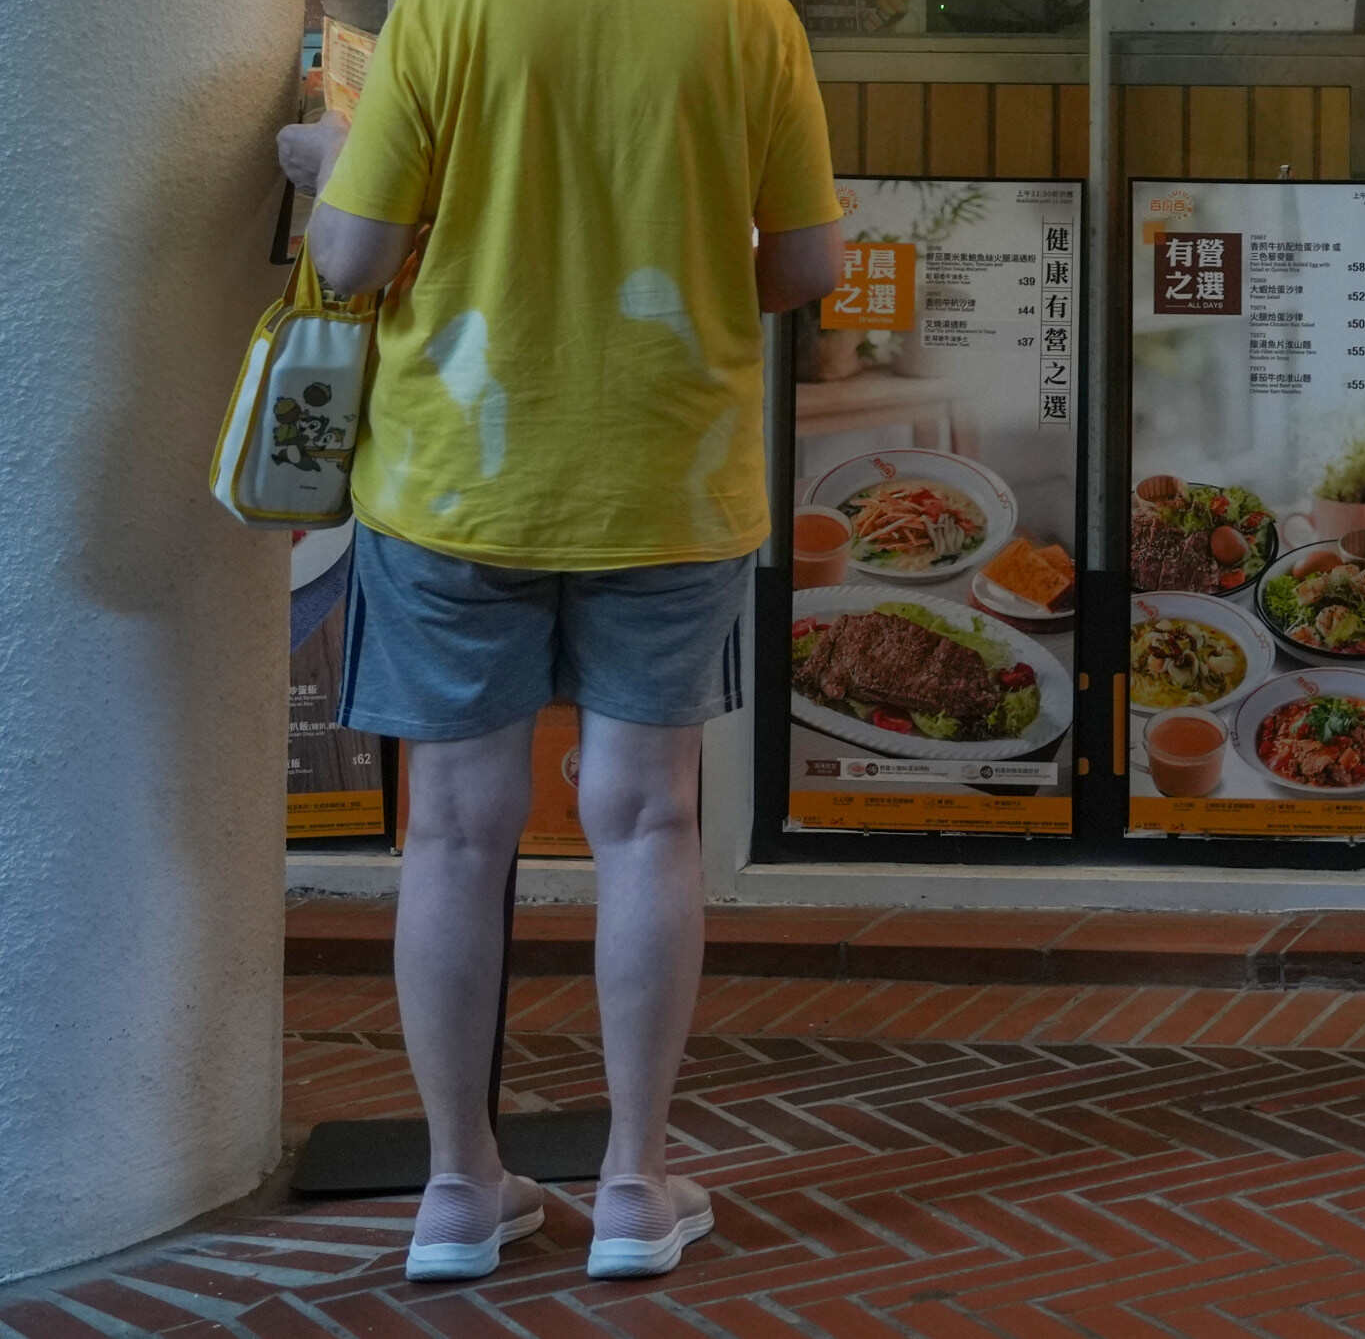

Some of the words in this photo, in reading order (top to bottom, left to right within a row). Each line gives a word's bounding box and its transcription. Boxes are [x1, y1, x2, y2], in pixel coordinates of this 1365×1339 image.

[1166, 238, 1224, 268] 有營
[1347, 263, 1365, 272] $58
[1166, 271, 1224, 300] 之選
[1347, 292, 1365, 301] $52
[1043, 227, 1071, 420] 健康有營之選
[1347, 319, 1365, 328] $50
[1017, 337, 1034, 347] $37
[1347, 347, 1365, 356] $55
[1347, 380, 1365, 389] $55
